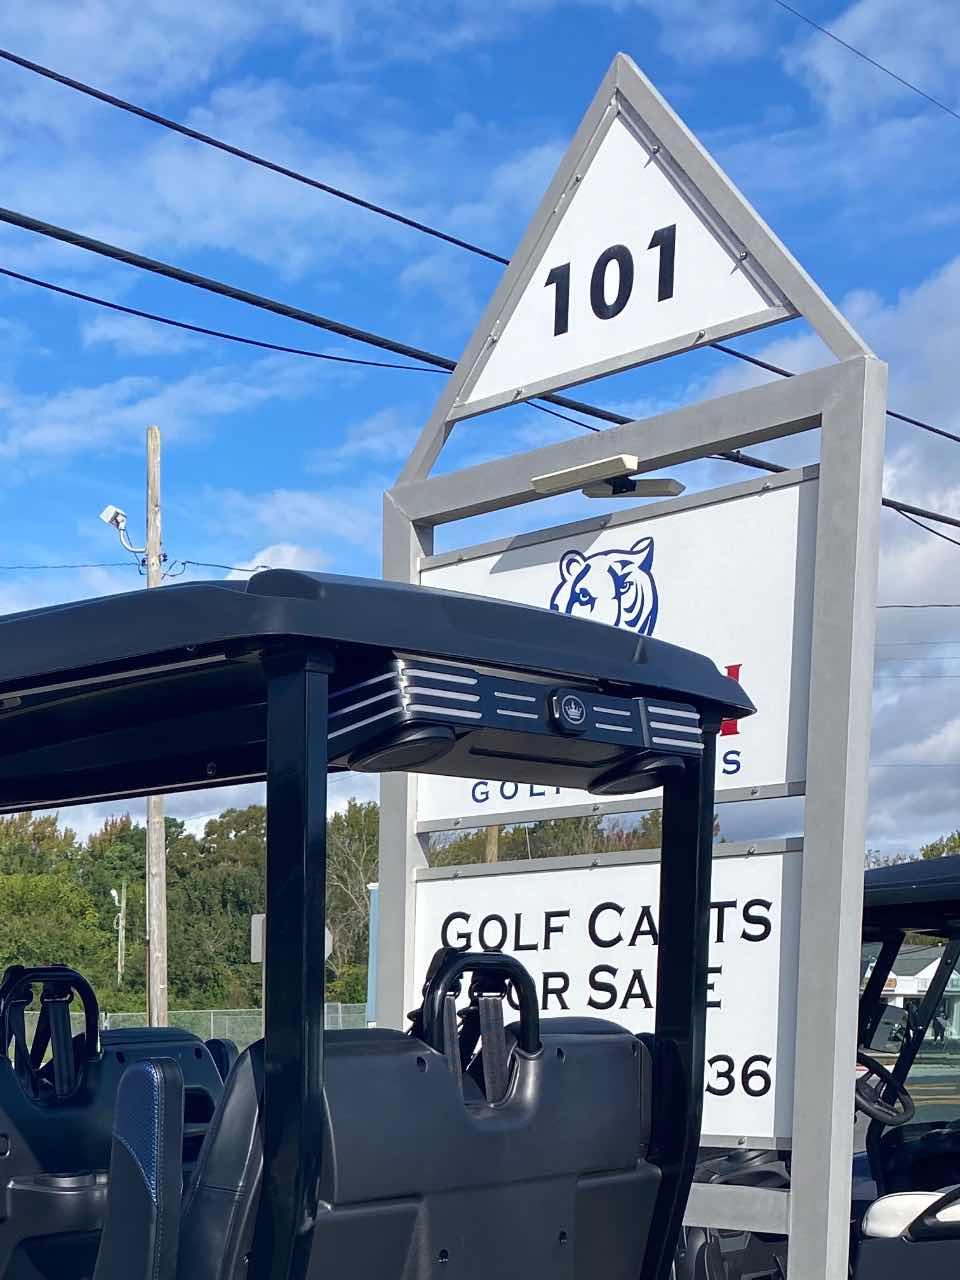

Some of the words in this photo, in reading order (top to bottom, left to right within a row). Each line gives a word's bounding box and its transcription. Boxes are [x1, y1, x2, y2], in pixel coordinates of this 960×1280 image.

[543, 223, 677, 337] 101
[441, 909, 571, 952] GOLF
[588, 898, 772, 949] CATS
[587, 964, 723, 1010] SAE
